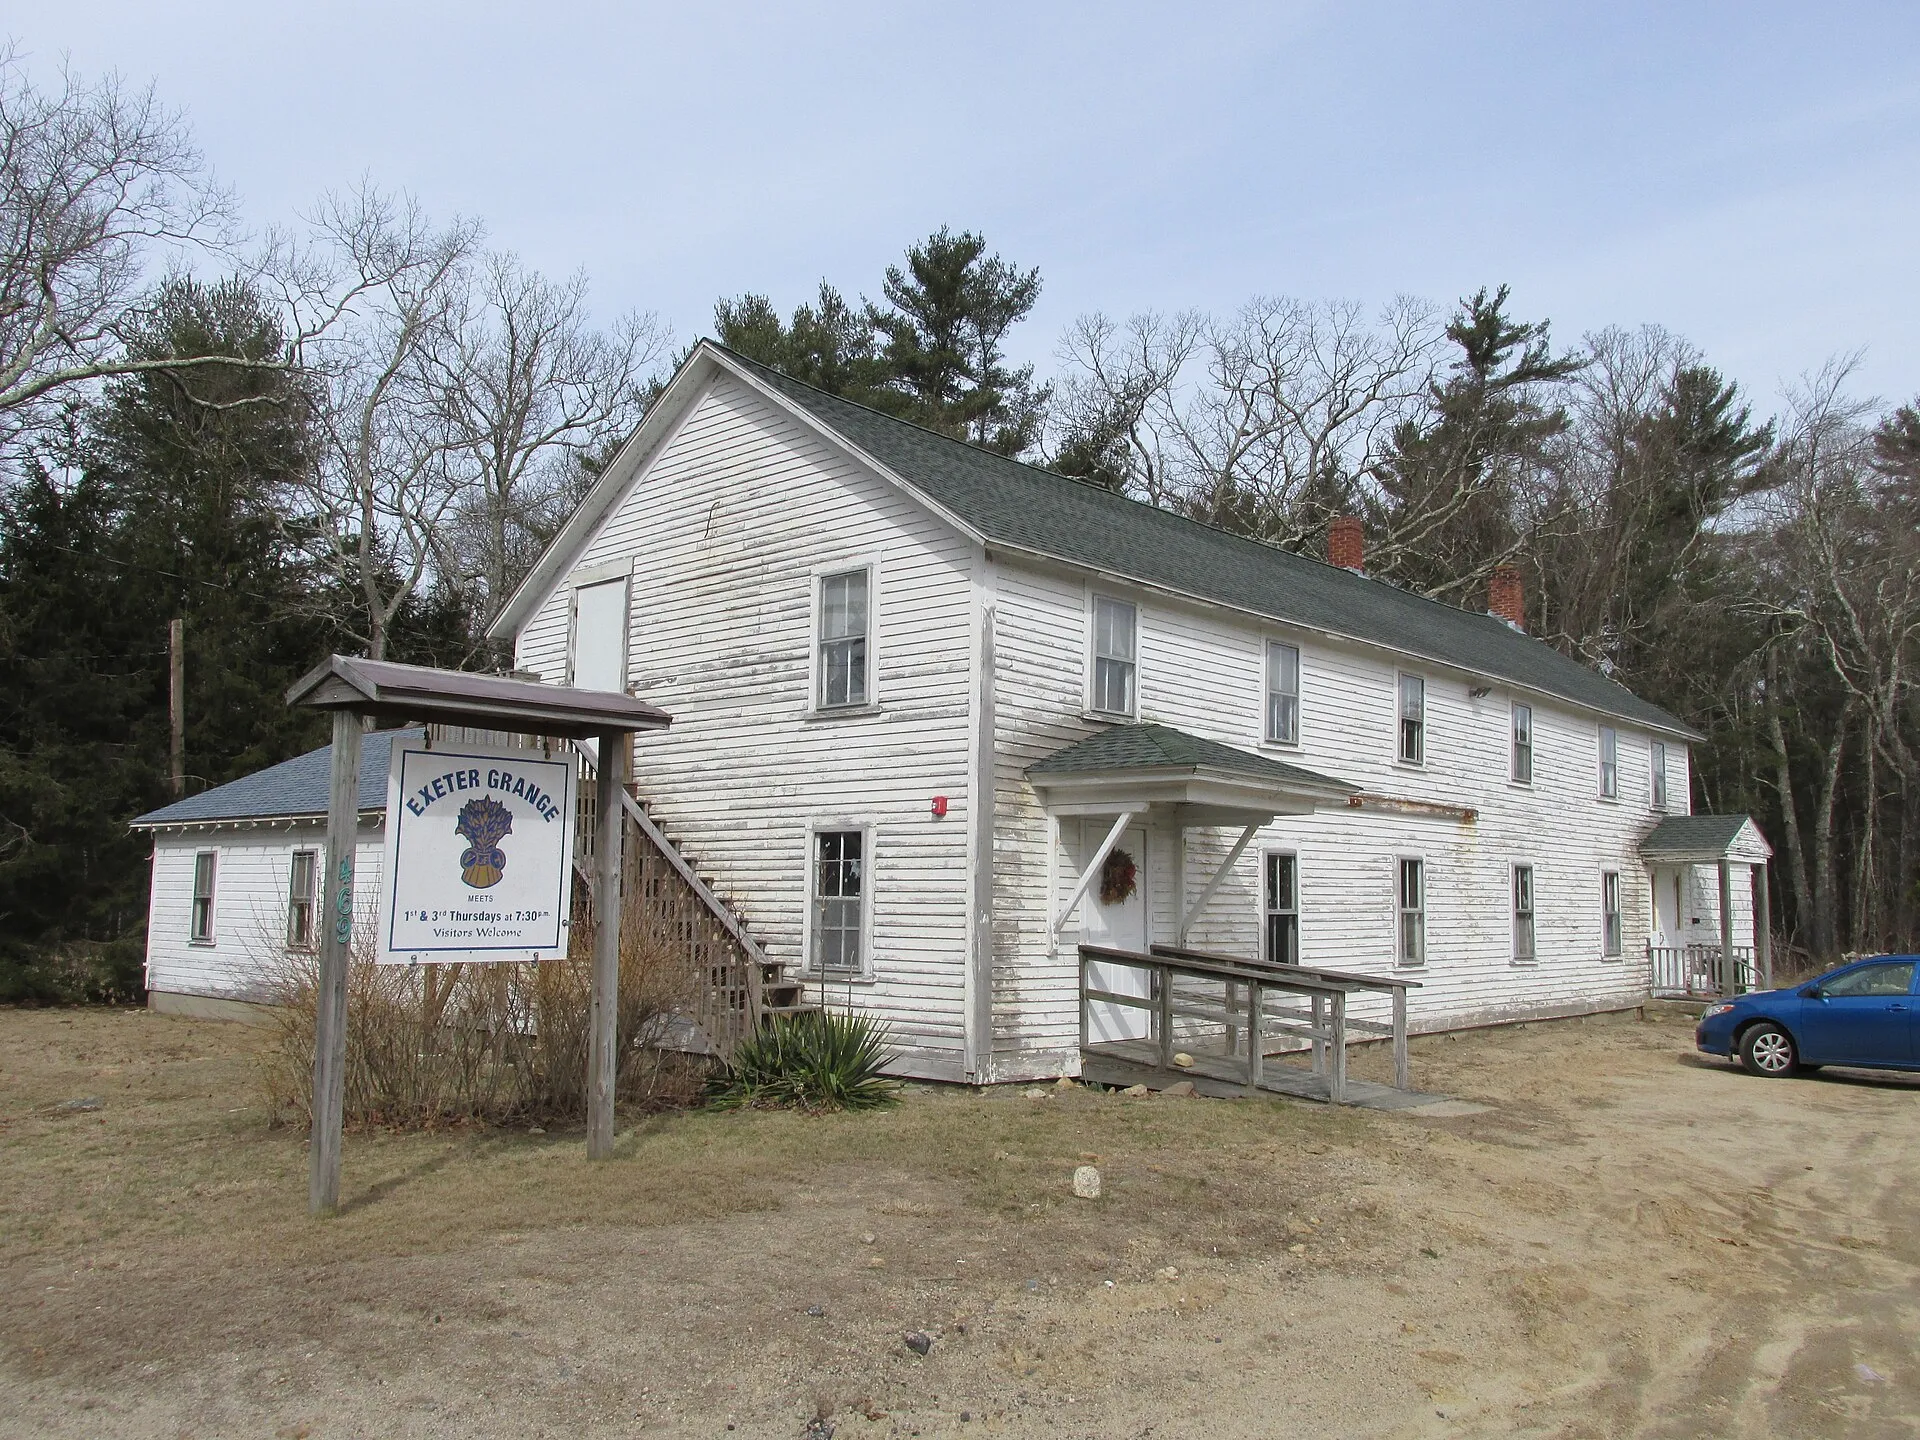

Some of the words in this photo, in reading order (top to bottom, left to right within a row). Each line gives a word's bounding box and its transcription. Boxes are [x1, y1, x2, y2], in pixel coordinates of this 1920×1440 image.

[406, 768, 480, 817] EXETER
[487, 769, 560, 823] GRANGE
[337, 855, 353, 944] 469
[404, 911, 417, 922] 1st
[420, 911, 428, 921] &
[432, 911, 447, 922] 3rd
[450, 911, 501, 923] Thursdays
[504, 913, 513, 921] at
[433, 928, 473, 938] Visitors
[476, 928, 522, 938] Welcome
